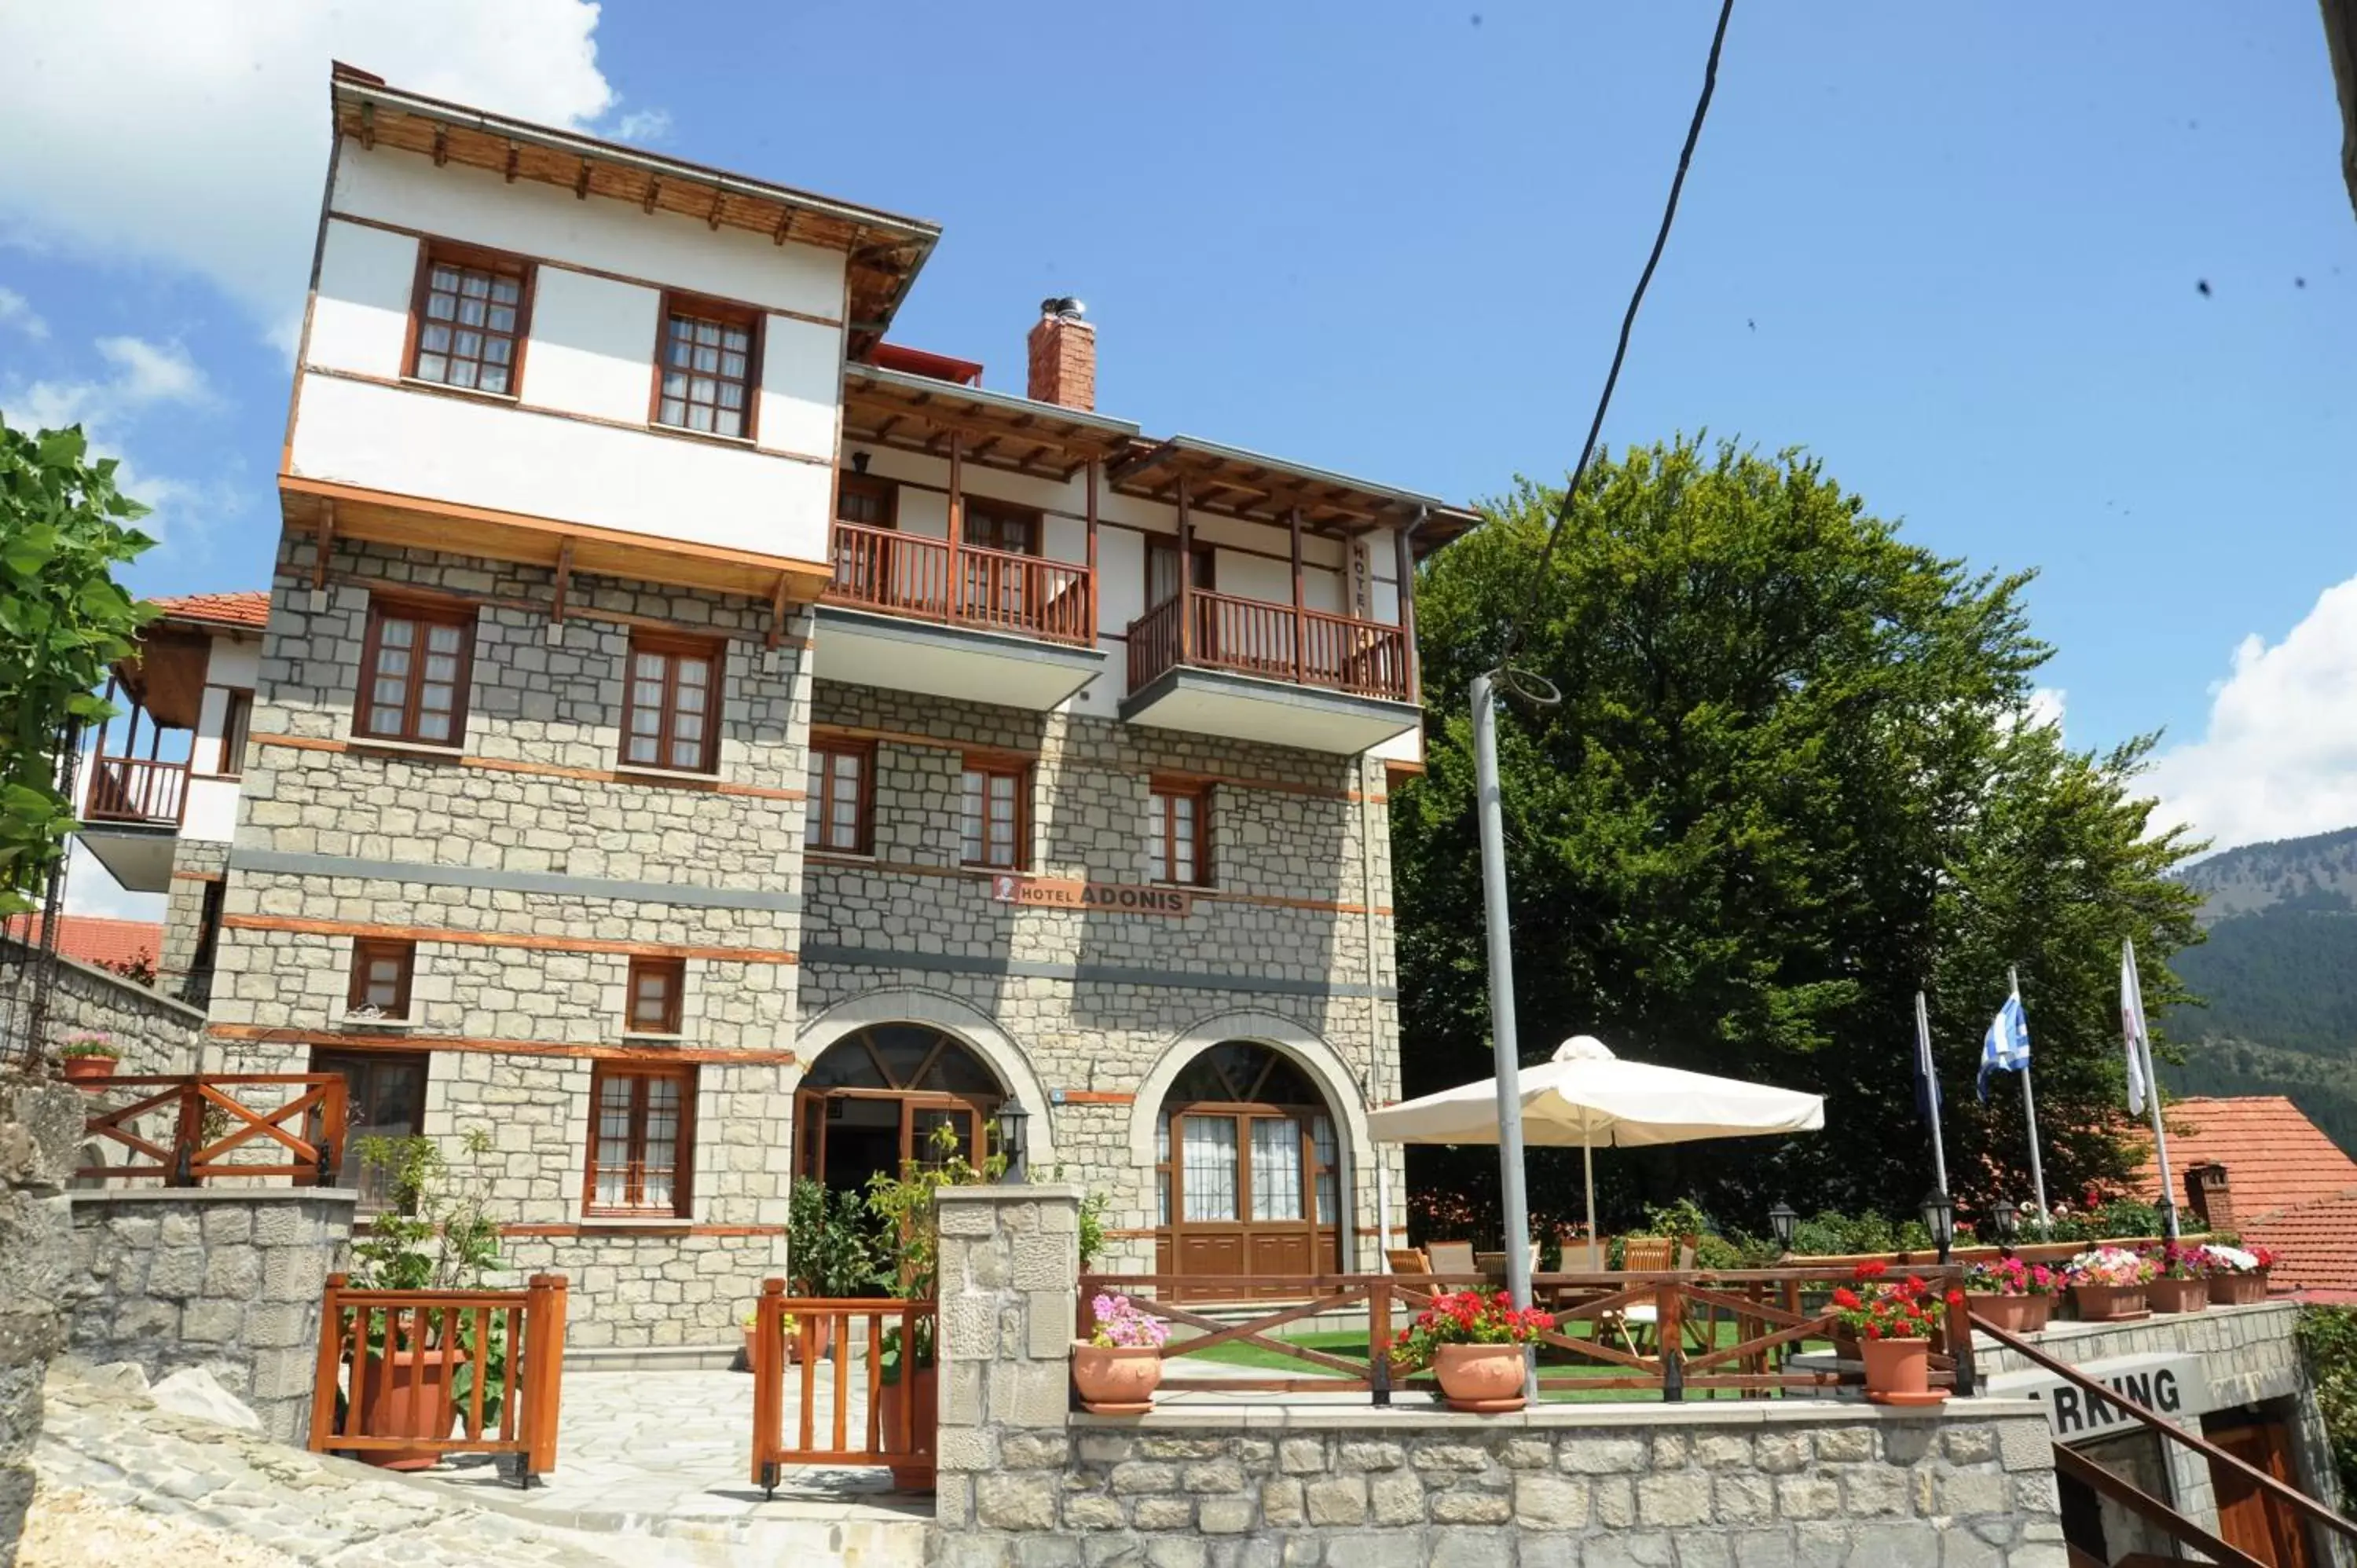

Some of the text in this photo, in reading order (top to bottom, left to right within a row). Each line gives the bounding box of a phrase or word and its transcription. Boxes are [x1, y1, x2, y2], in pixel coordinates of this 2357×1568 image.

[1022, 885, 1183, 911] HOTEL ADONIS
[2029, 1368, 2180, 1436] RKING
